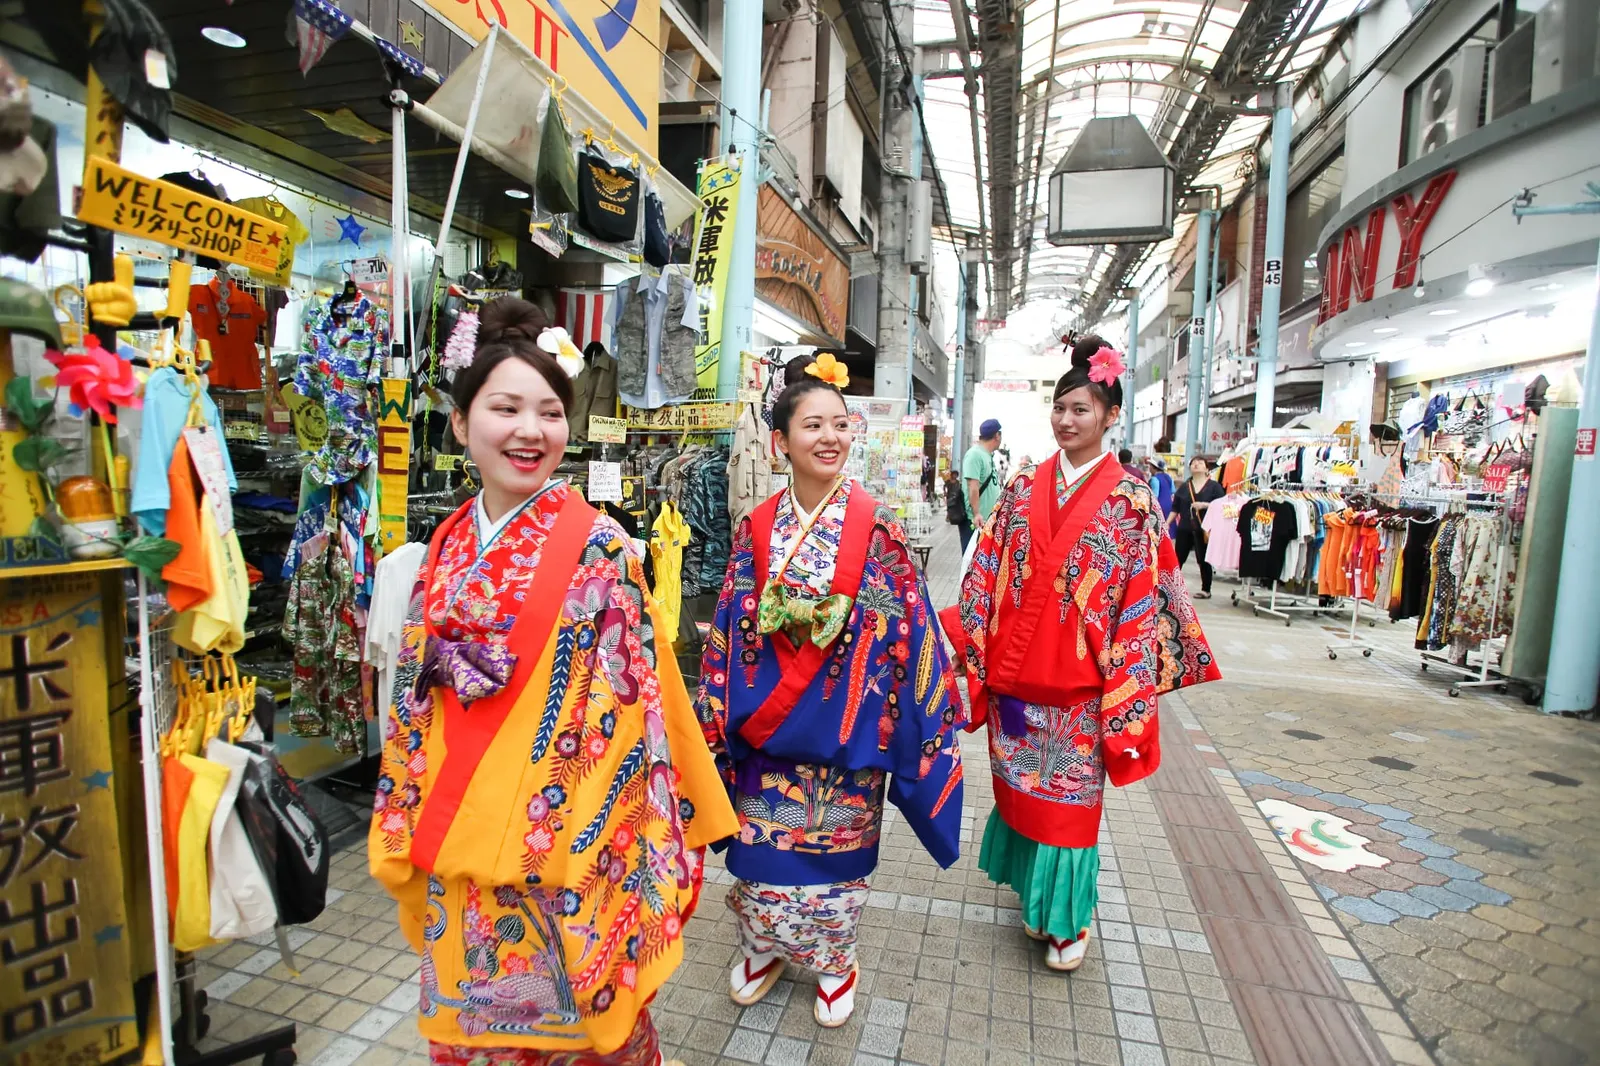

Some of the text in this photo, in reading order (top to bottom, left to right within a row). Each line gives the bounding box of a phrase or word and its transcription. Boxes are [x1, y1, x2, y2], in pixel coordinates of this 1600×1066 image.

[96, 167, 264, 244] WEL-COME
[1266, 260, 1281, 272] B
[1265, 274, 1281, 285] 45
[1195, 317, 1205, 326] B
[1193, 327, 1205, 336] 46
[1485, 466, 1508, 478] SALE
[1482, 479, 1505, 492] SALE
